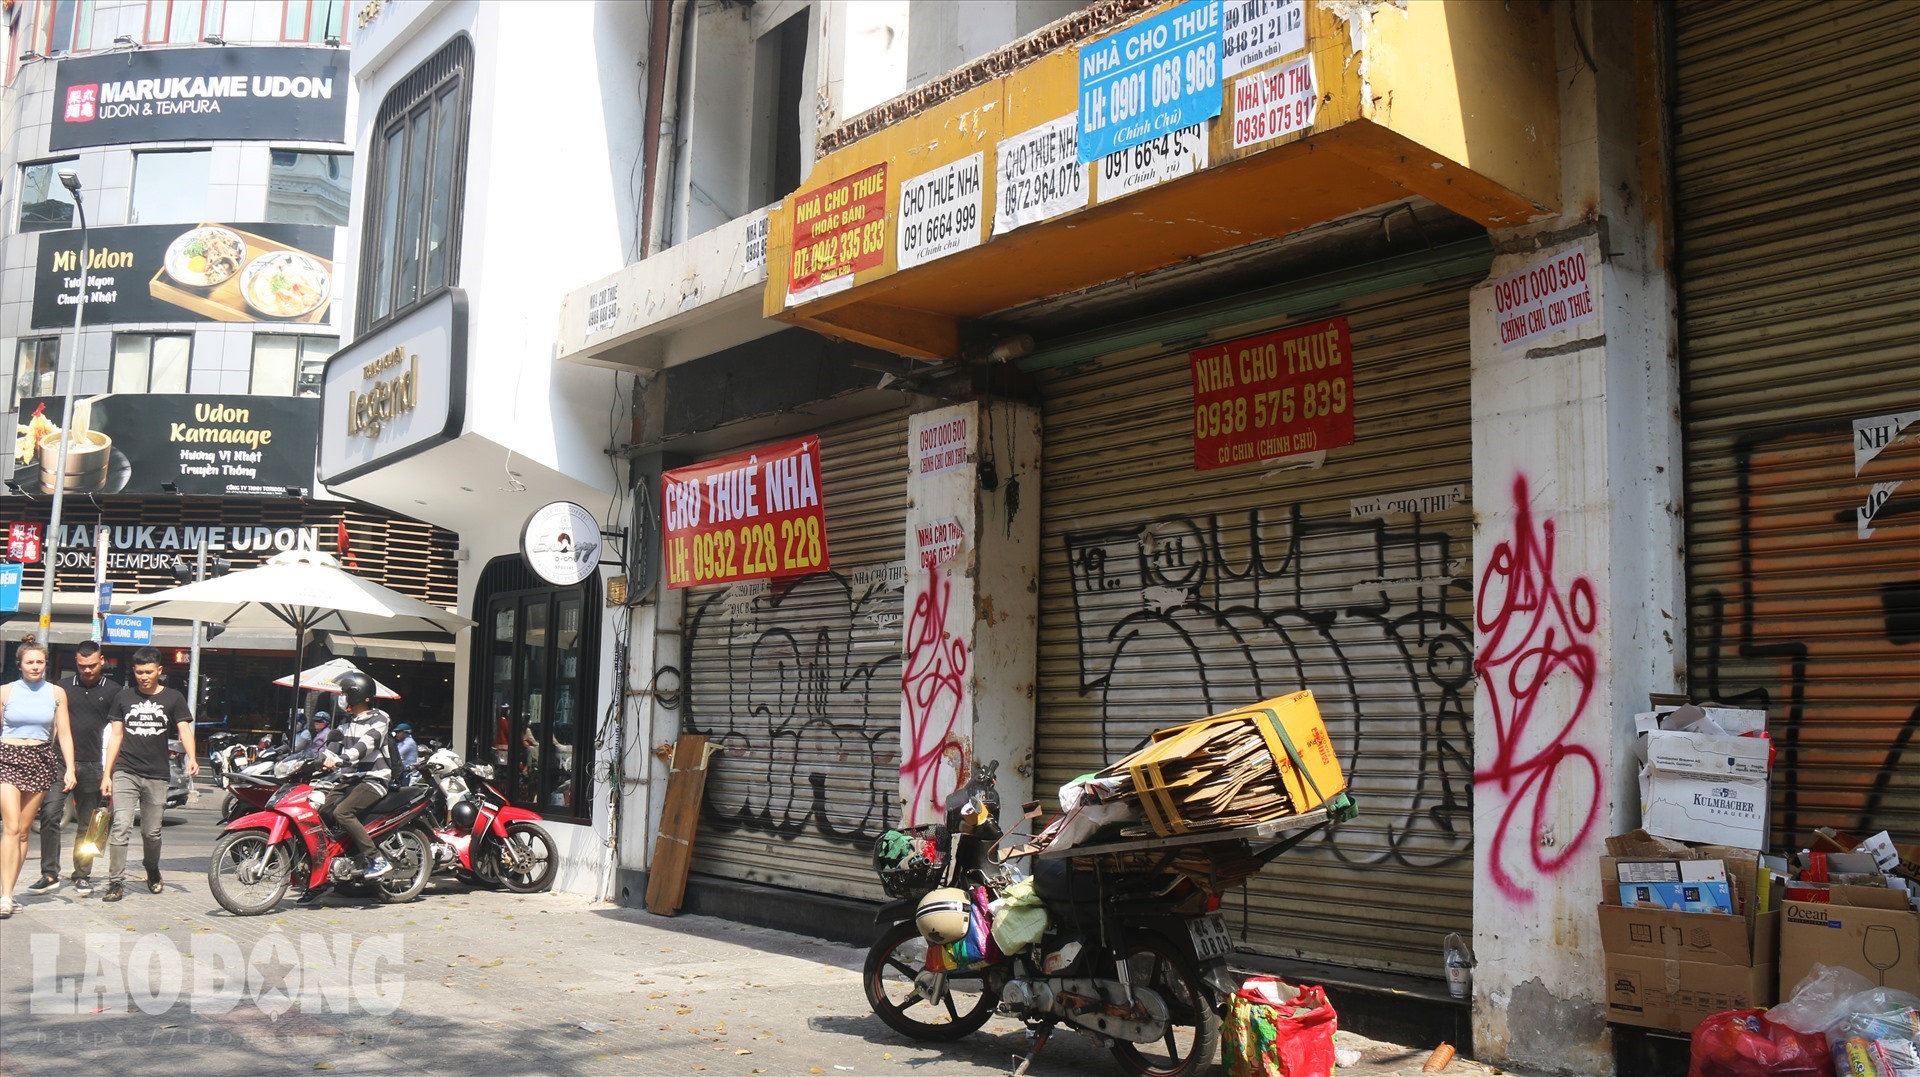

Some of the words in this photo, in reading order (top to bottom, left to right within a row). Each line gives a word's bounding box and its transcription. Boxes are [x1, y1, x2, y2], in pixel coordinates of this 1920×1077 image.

[1251, 24, 1264, 46] 21
[1268, 16, 1282, 39] 21
[1288, 8, 1300, 32] 12
[1083, 40, 1120, 79] NHÀ
[1126, 26, 1168, 62] CHO
[100, 76, 247, 104] MARUKAME
[252, 77, 332, 99] UDON
[100, 103, 140, 120] UDON
[142, 102, 153, 116] &
[156, 100, 221, 114] TEMPURA
[1084, 87, 1106, 134] LH:
[1110, 70, 1146, 124] 0901
[1152, 55, 1181, 108] 068
[1186, 42, 1216, 96] 968
[1238, 77, 1259, 113] NHÀ
[1262, 72, 1285, 104] CHO
[1289, 64, 1311, 95] THU
[1236, 112, 1265, 144] 0936
[1270, 104, 1291, 135] 075
[1005, 145, 1026, 181] CHO
[1028, 126, 1056, 169] THUÊ
[797, 194, 821, 224] NHÀ
[824, 186, 848, 212] CHO
[852, 170, 885, 201] THUÊ
[904, 186, 924, 218] CHO
[928, 166, 954, 208] THUÊ
[957, 157, 979, 199] NHÀ
[1005, 162, 1080, 216] 0972.964.076
[811, 240, 837, 273] 0942
[840, 228, 861, 262] 335
[863, 219, 885, 255] 833
[904, 222, 923, 251] 091
[926, 211, 952, 242] 6664
[956, 203, 976, 234] 999
[1501, 313, 1528, 343] CHÍNH
[1528, 300, 1547, 333] CHỦ
[1549, 300, 1567, 326] CHO
[1568, 284, 1593, 319] THUÊ
[1196, 347, 1234, 393] NHÀ
[1239, 343, 1278, 385] CHO
[1284, 322, 1342, 375] THUÊ
[195, 403, 249, 423] Udon
[1197, 396, 1247, 440] 0938
[1254, 387, 1295, 428] 575
[1303, 376, 1346, 420] 839
[170, 422, 272, 450] Kamaage
[665, 478, 700, 532] CHO
[706, 455, 759, 524] THUÊ
[765, 442, 818, 514] NHÀ
[108, 553, 184, 570] TEMPURA
[232, 526, 319, 552] UDON
[669, 537, 690, 583] LH:
[693, 529, 737, 581] 0932
[741, 523, 778, 574] 228
[782, 516, 821, 569] 228
[1693, 793, 1754, 812] KULMBACHER
[1711, 809, 1761, 819] BRAUEREI
[1788, 905, 1828, 921] Ocean
